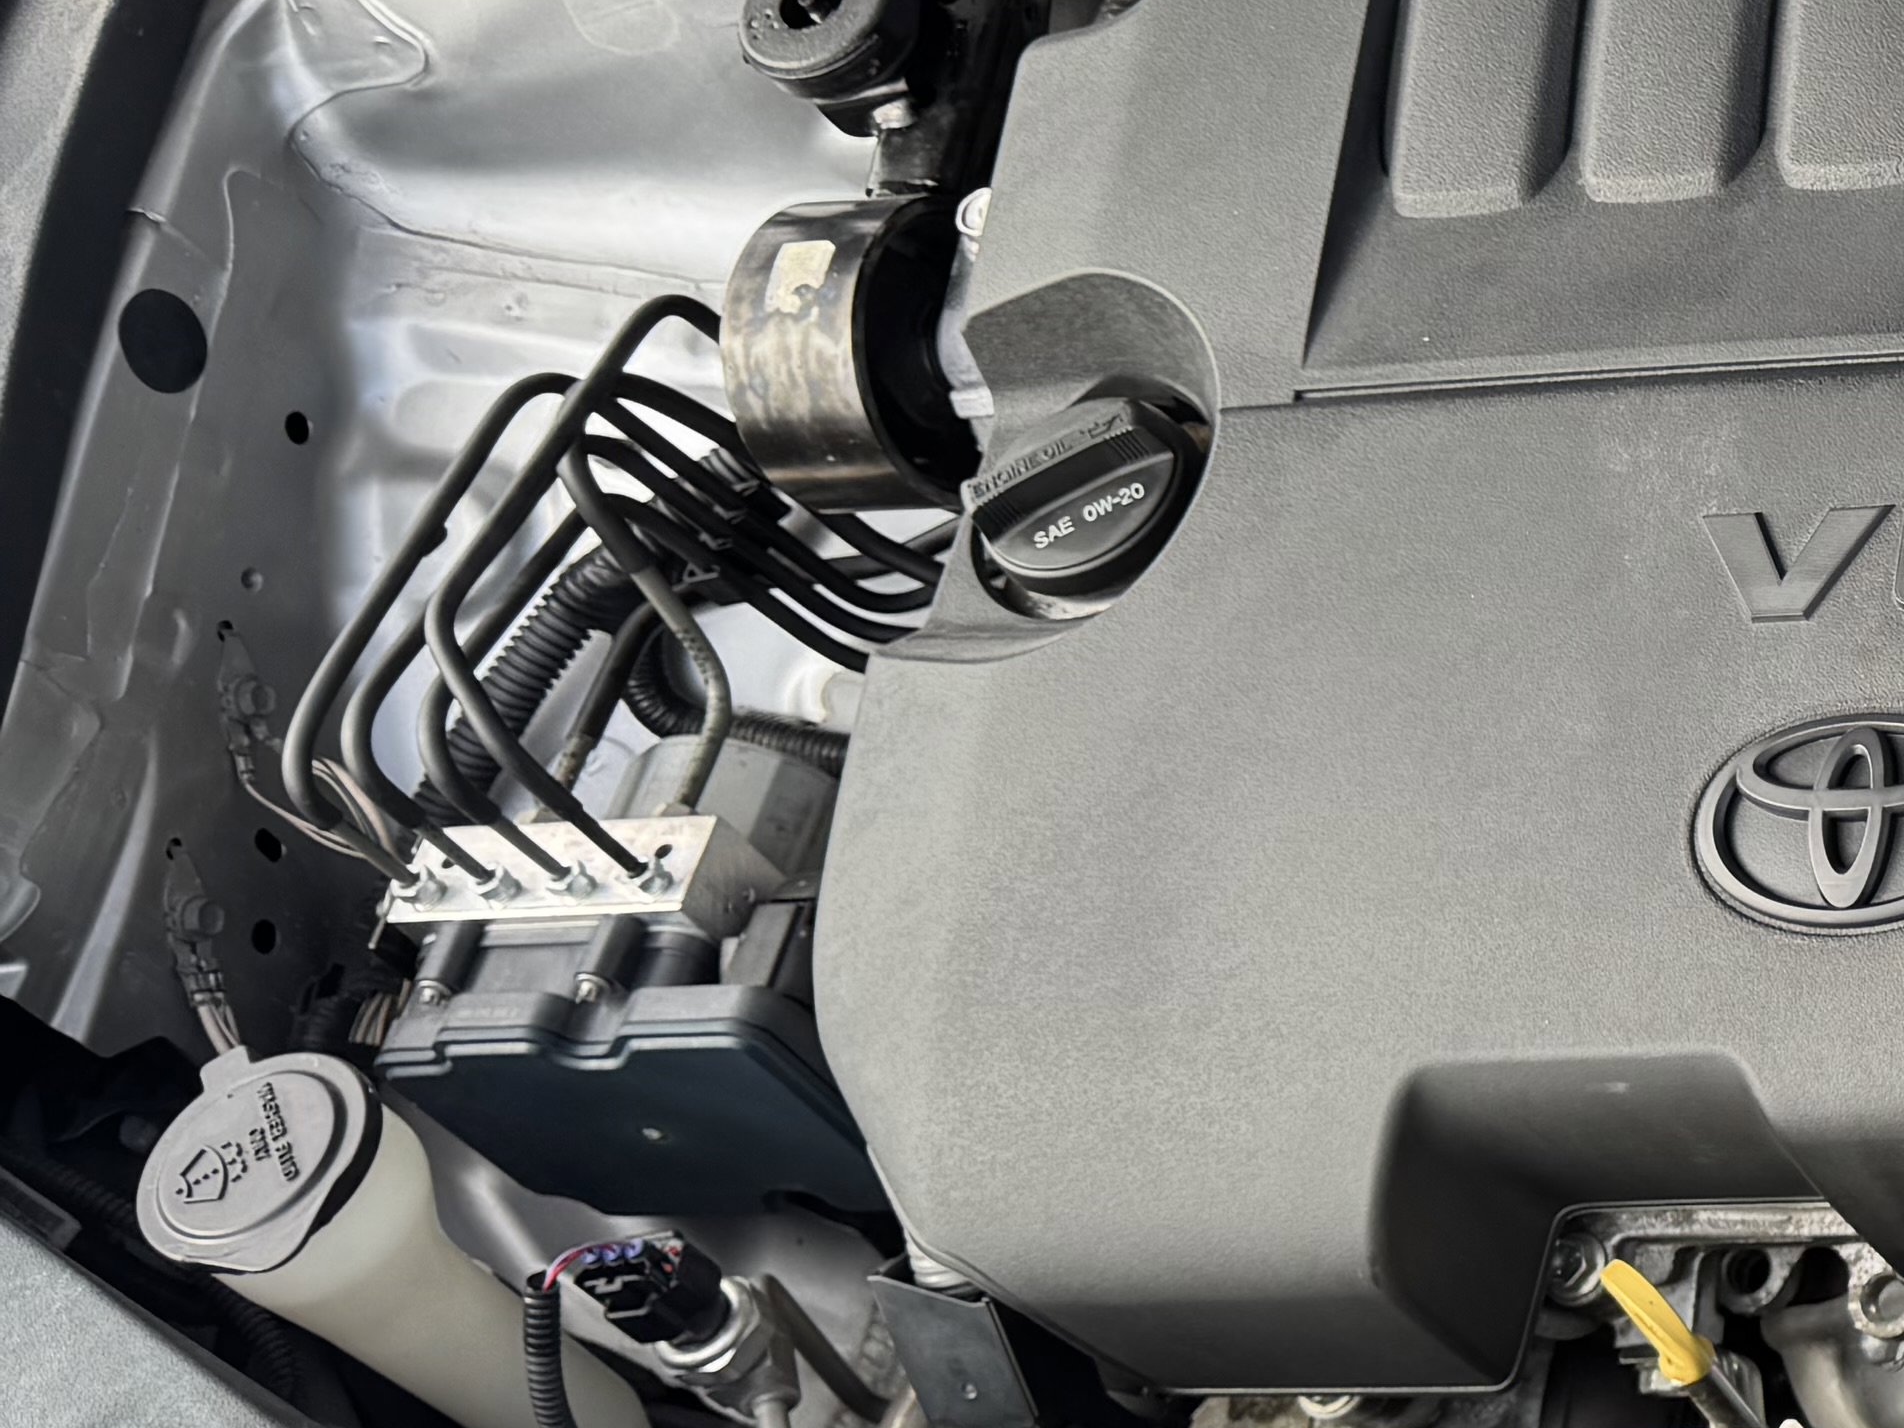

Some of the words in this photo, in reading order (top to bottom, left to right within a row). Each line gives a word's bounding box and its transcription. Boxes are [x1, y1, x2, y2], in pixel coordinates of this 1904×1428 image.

[1041, 440, 1074, 462] OIL
[1033, 516, 1075, 549] SAE
[1083, 483, 1145, 522] 0W-20
